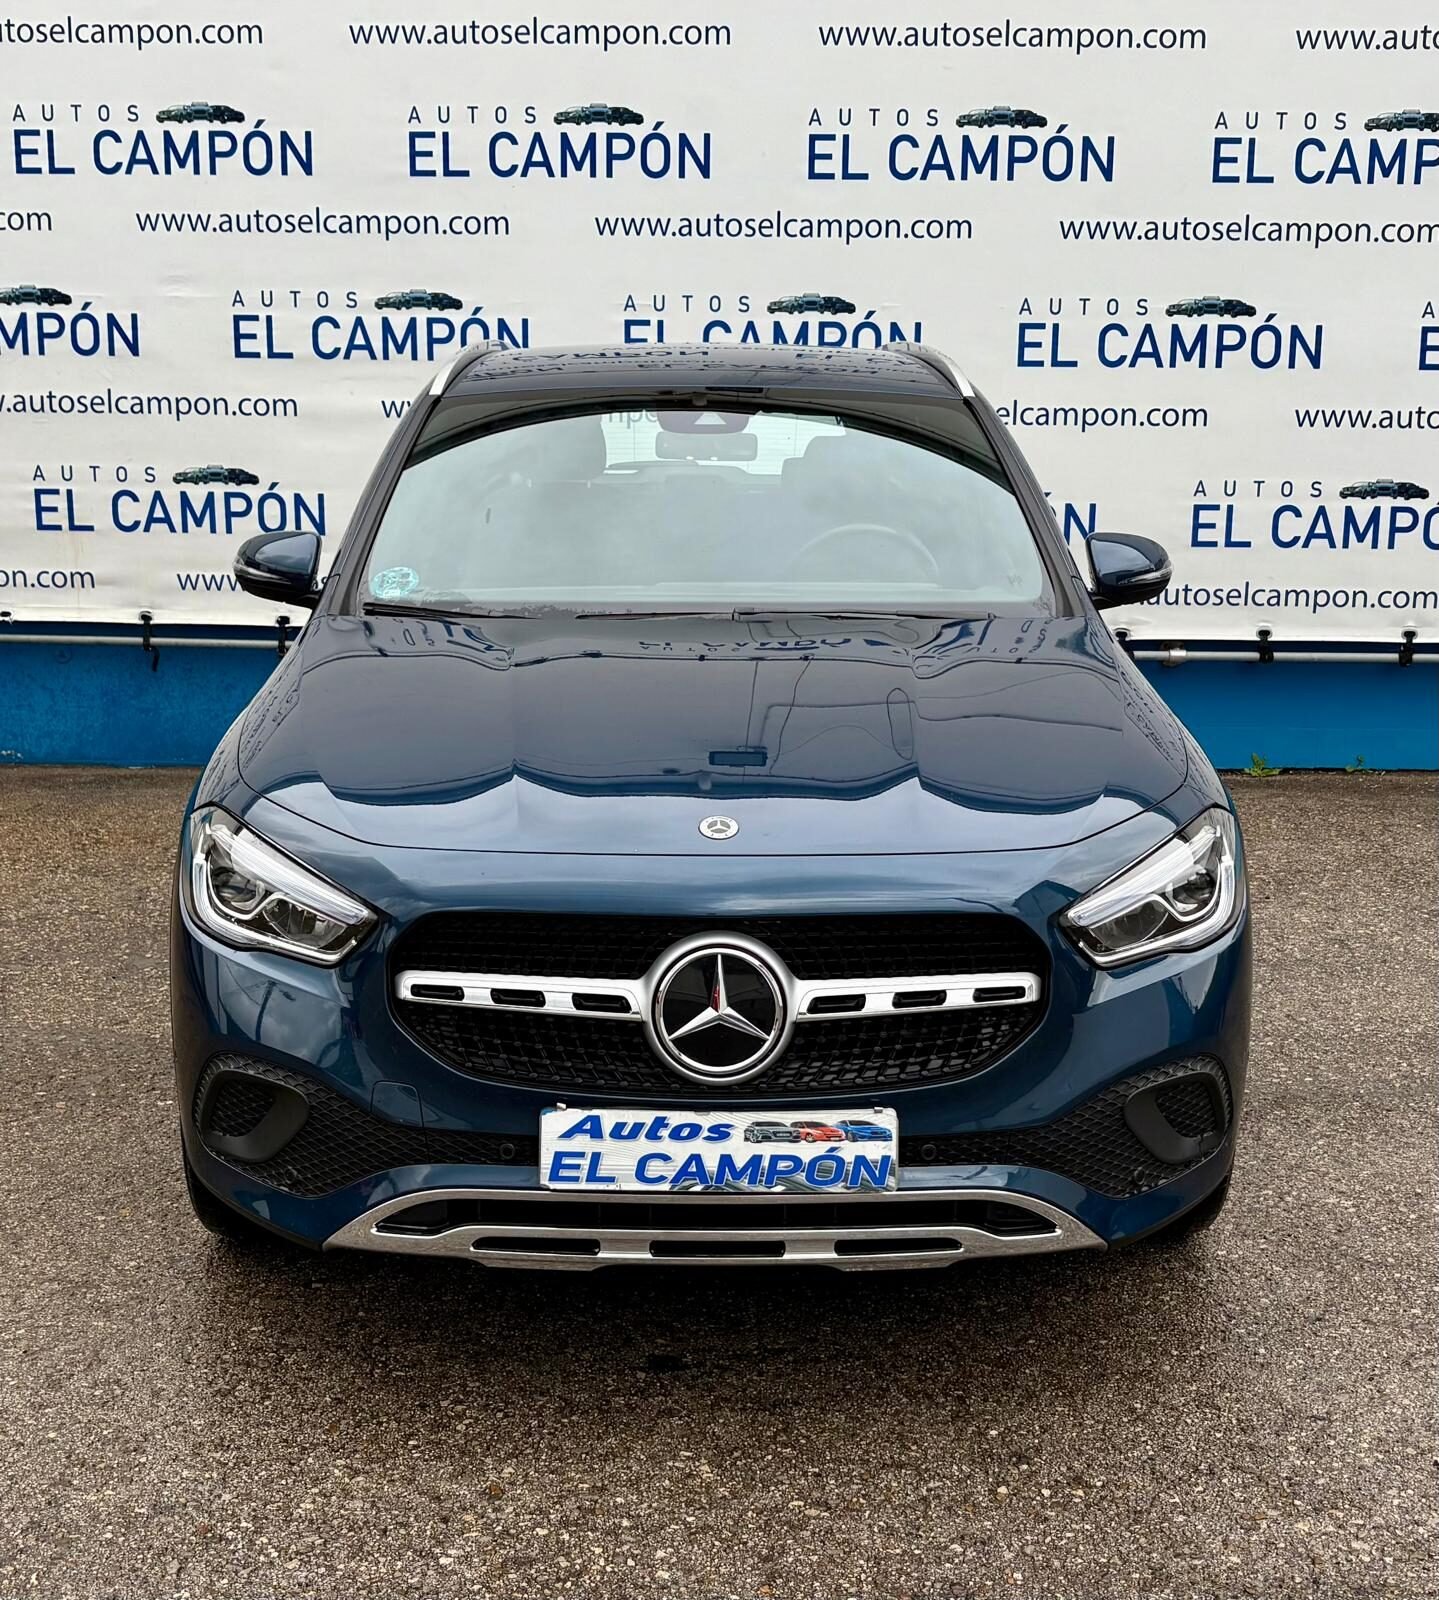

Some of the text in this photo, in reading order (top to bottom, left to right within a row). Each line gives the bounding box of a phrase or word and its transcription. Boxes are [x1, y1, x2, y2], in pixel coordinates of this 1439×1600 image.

[0, 15, 263, 51] toselcampon.com
[348, 16, 731, 52] www.autoselcampon.com
[818, 19, 1206, 55] www.autoselcampon.com
[12, 103, 139, 123] AUTOS
[407, 105, 537, 124] AUTOS
[808, 107, 939, 127] AUTOS
[1214, 111, 1347, 131] AUTOS
[13, 119, 313, 176] EL CAMPÓN
[408, 121, 711, 180] EL CAMPÓN
[807, 123, 1115, 183] EL CAMPÓN
[1212, 137, 1439, 185] EL CAMP
[135, 206, 509, 242] www.autoselcampon.com
[594, 210, 972, 246] www.autoselcampon.com
[1059, 214, 1439, 249] www.autoselcampon.com
[231, 289, 358, 309] AUTOS
[623, 294, 750, 313] AUTOS
[1018, 297, 1148, 316] AUTOS
[232, 306, 530, 361] EL CAMPÓN
[1017, 313, 1323, 370] EL CAMPÓN
[0, 388, 298, 420] .autoselcampon.com
[32, 464, 156, 484] AUTOS
[1193, 479, 1322, 498] AUTOS
[33, 481, 326, 536] EL CAMPÓN
[1190, 503, 1252, 548] EL
[557, 1114, 736, 1143] Autos
[548, 1147, 892, 1188] EL CAMPÓN
